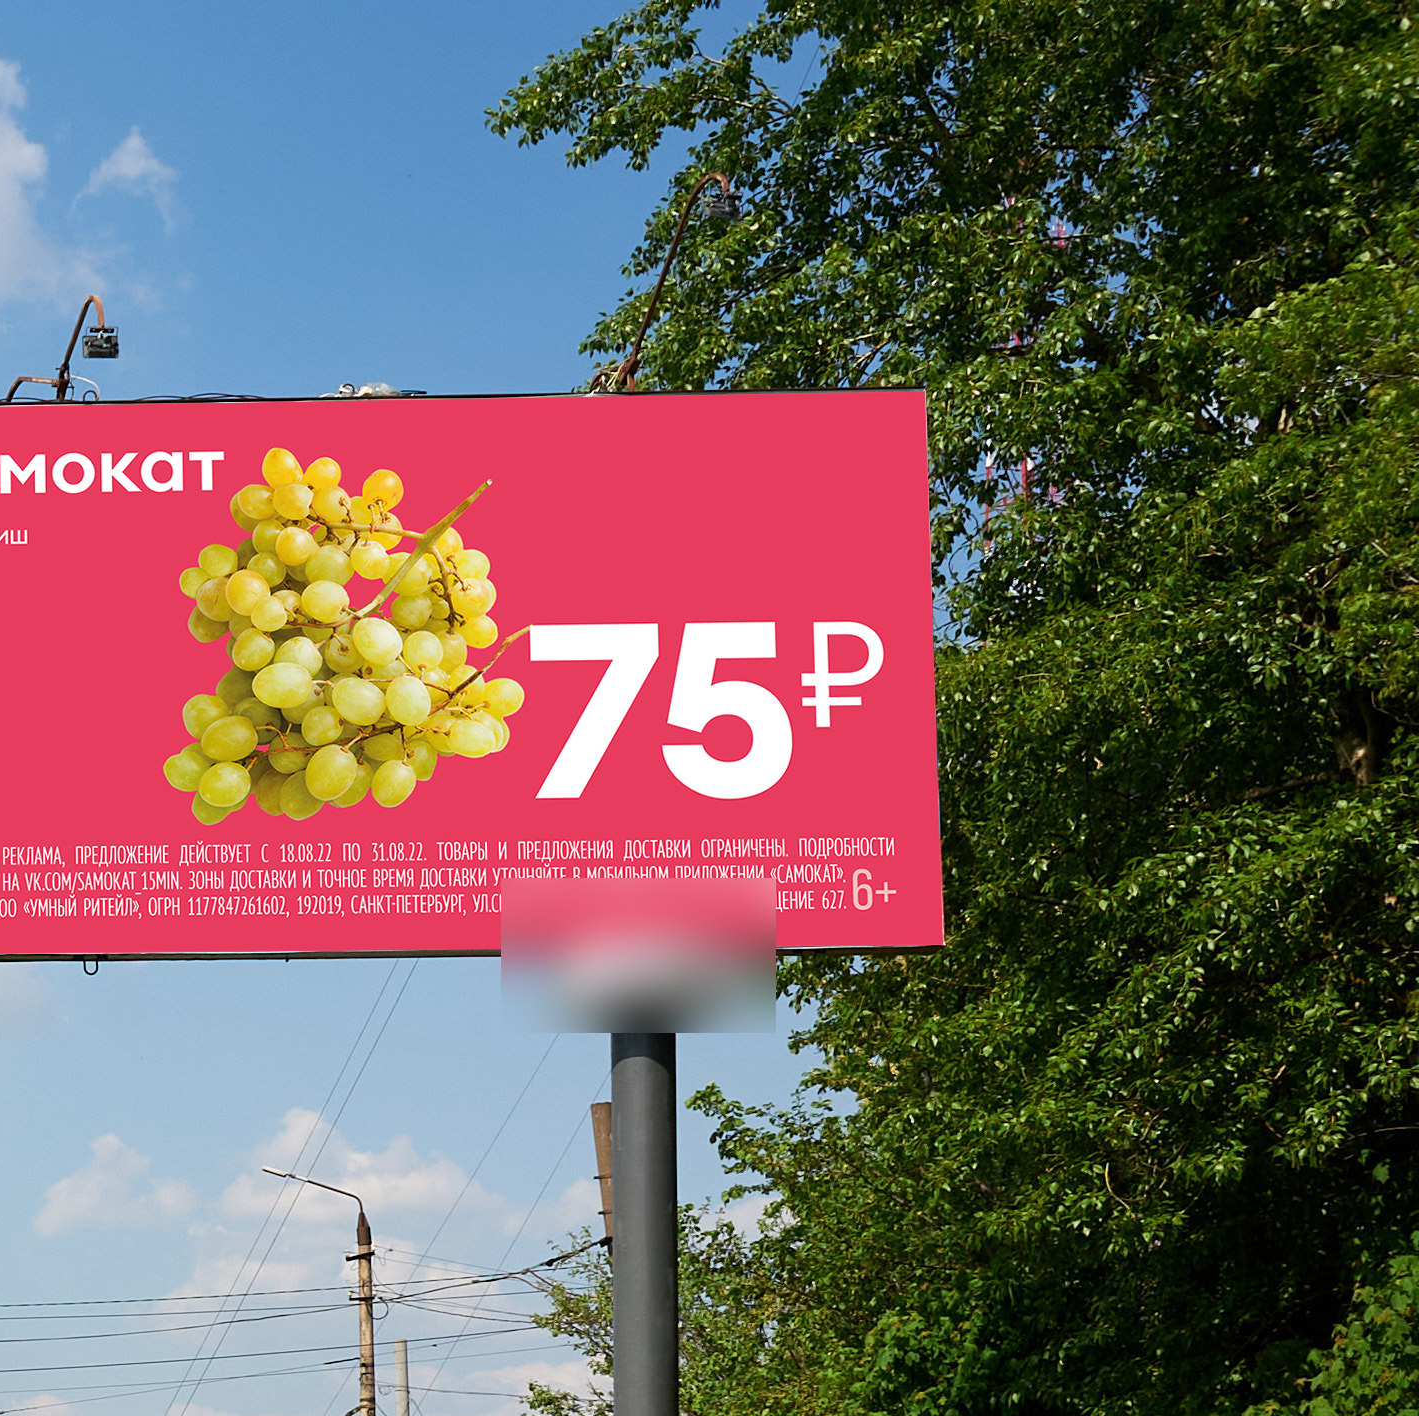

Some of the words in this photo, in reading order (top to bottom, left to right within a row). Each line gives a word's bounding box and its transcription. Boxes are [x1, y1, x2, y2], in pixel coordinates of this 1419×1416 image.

[2, 845, 66, 868] РЕКЛАМА,
[75, 844, 170, 868] ПРЕДЛОЖЕНИЕ
[178, 840, 252, 867] ДЕЙСТВУЕТ
[260, 843, 270, 863] С
[279, 842, 332, 863] 18.08.22
[342, 842, 361, 862] ПО
[371, 841, 427, 862] 31.08.22.
[436, 841, 488, 861] ТОВАРЫ
[498, 841, 508, 860] И
[517, 839, 614, 863] ПРЕДЛОЖЕНИЯ
[623, 839, 691, 862] ДОСТАВКИ
[700, 838, 789, 859] ОГРАНИЧЕНЫ.
[798, 836, 895, 860] ПОДРОБНОСТИ
[2, 872, 21, 892] НА
[24, 870, 183, 895] VK.COM/SAMOKAT_15MIN.
[188, 870, 225, 890] ЗОНЫ
[229, 869, 297, 893] ДОСТАВКИ
[302, 869, 312, 889] И
[316, 868, 368, 889] ТОЧНОЕ
[372, 867, 415, 888] ВРЕМЯ
[419, 867, 487, 891] ДОСТАВКИ
[769, 863, 845, 884] «САМОКАТ».
[852, 867, 897, 911] 6+
[23, 893, 77, 918] «УМНЫЙ
[83, 892, 143, 920] РИТЕЙЛ»,
[148, 896, 181, 917] ОГРН
[187, 895, 290, 918] 1177847261602,
[296, 894, 345, 918] 192019,
[350, 893, 467, 917] САНКТ-ПЕТЕРБУРГ,
[821, 889, 847, 910] 627.
